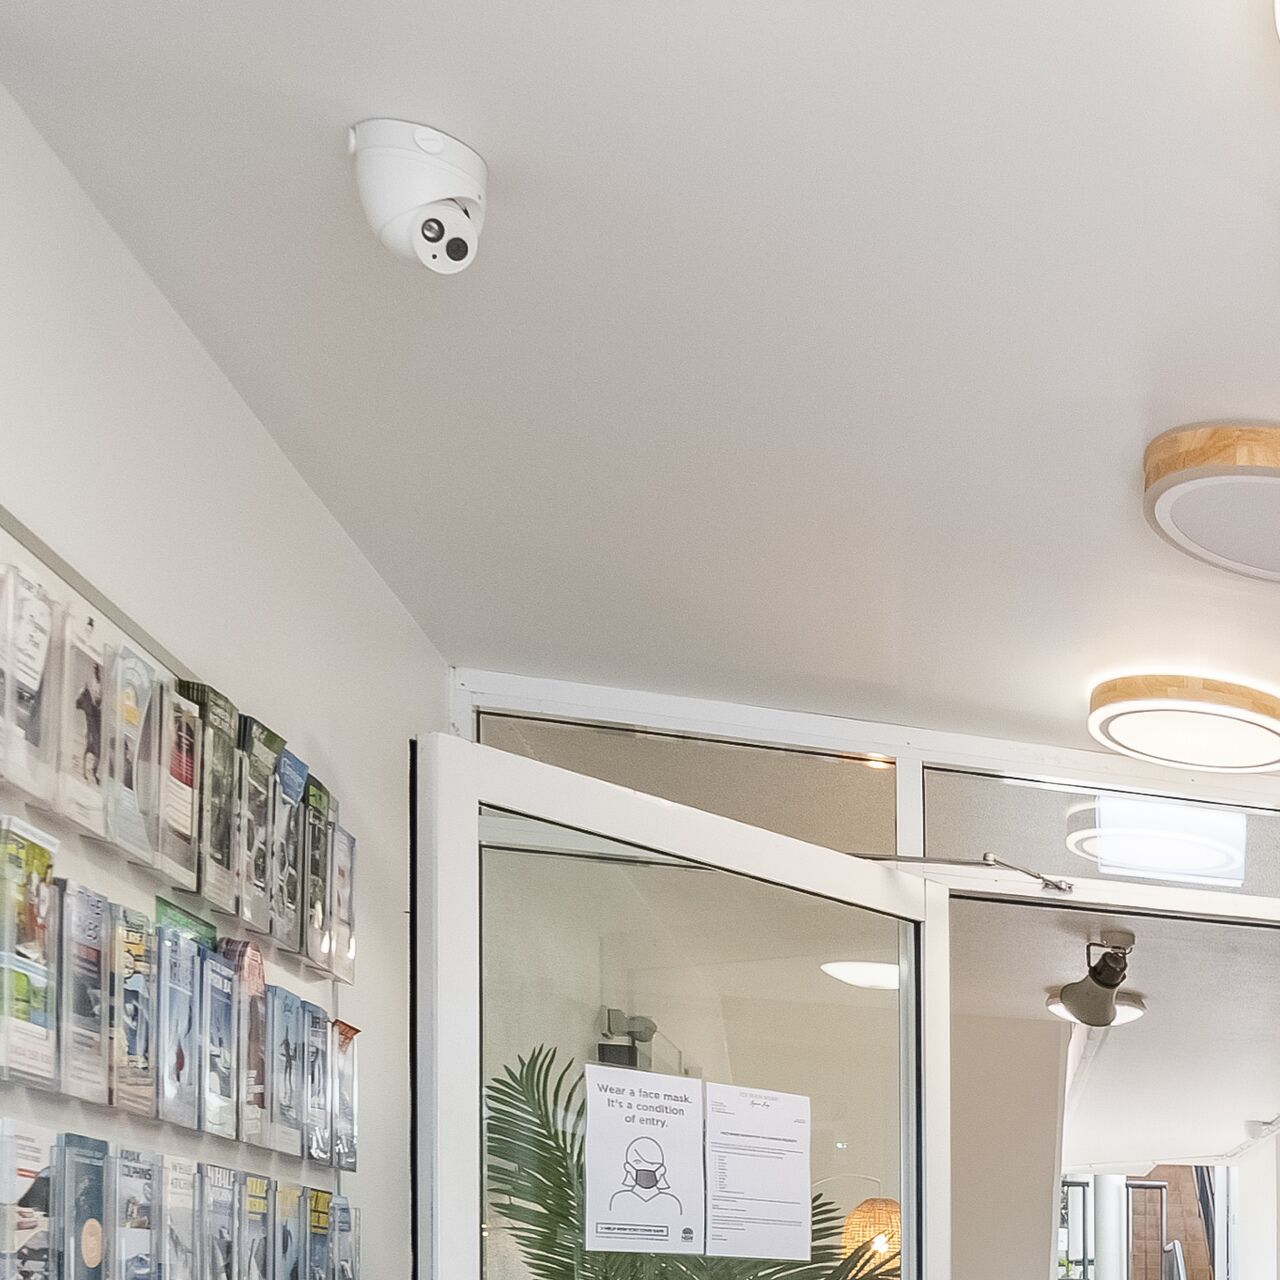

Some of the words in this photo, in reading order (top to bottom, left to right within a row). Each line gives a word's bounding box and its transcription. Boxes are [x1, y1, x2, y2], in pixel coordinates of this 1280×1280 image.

[597, 1083, 626, 1096] Wear
[638, 1087, 660, 1100] face
[663, 1092, 693, 1104] mask.
[607, 1098, 623, 1109] It's
[626, 1102, 632, 1110] a
[636, 1102, 685, 1116] condition
[624, 1114, 637, 1124] of
[639, 1116, 669, 1128] entry.
